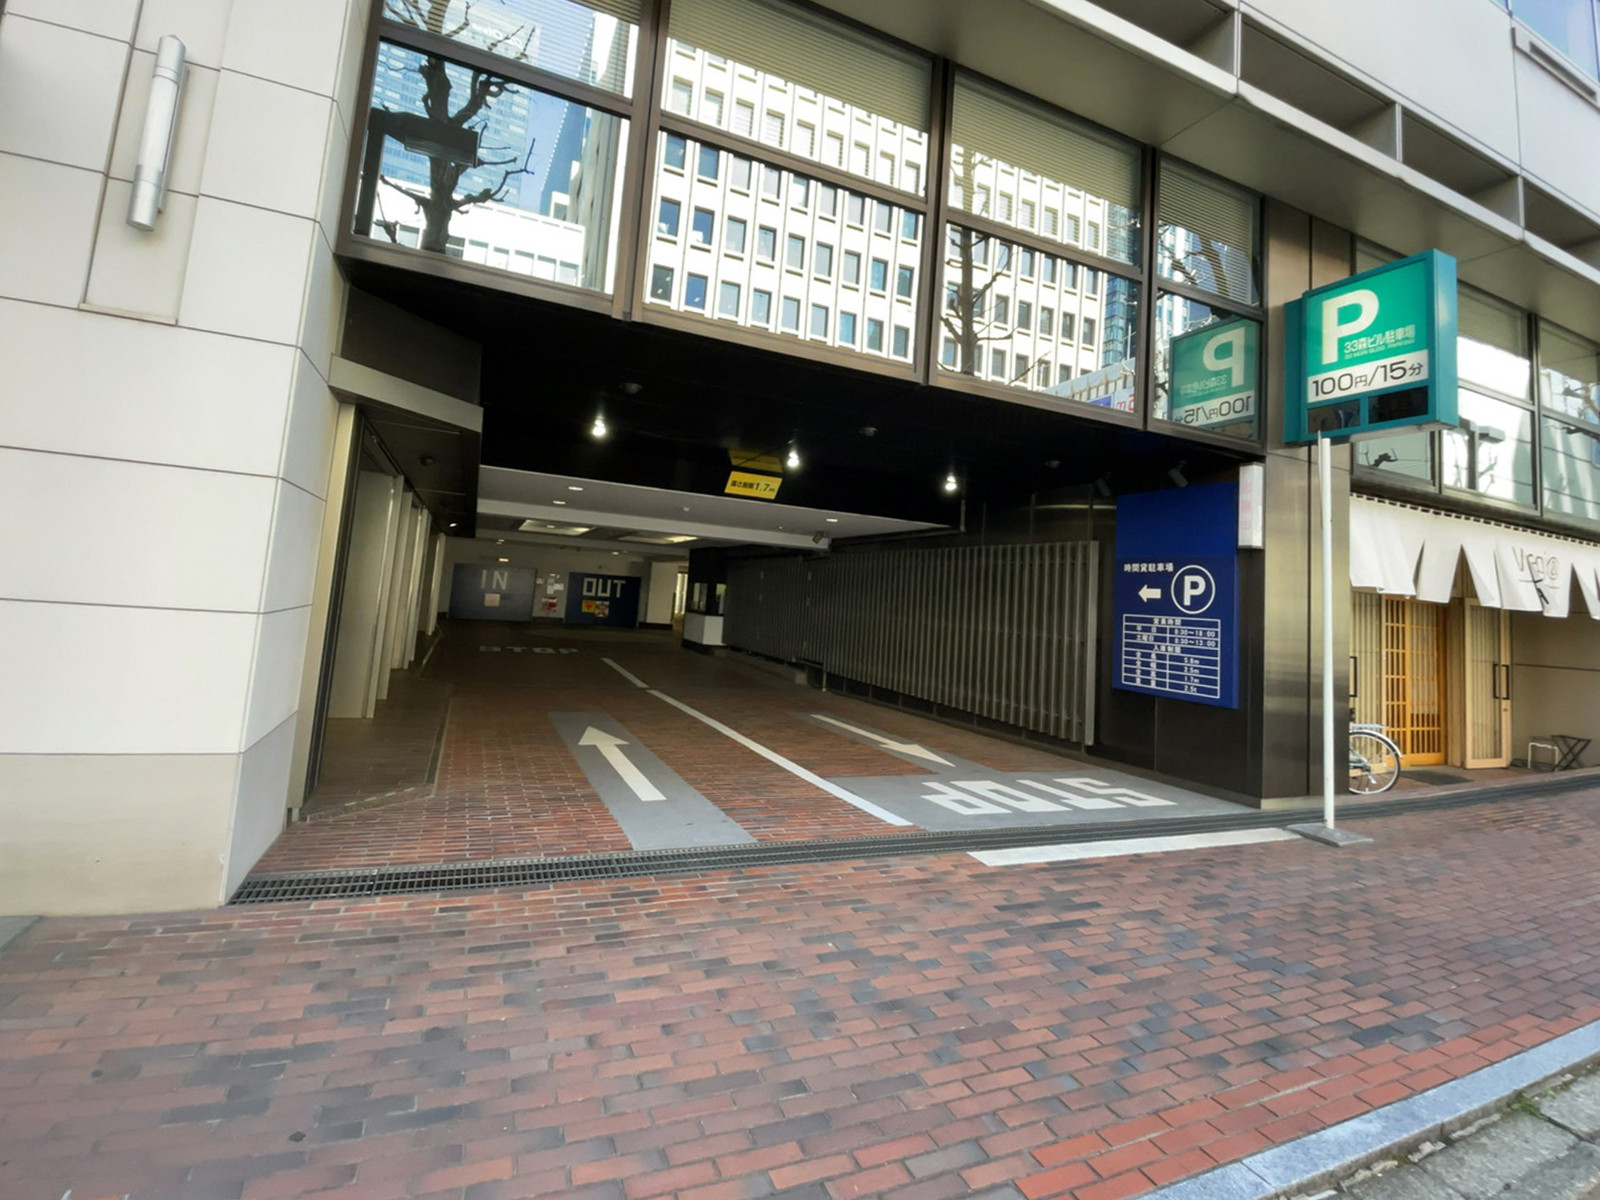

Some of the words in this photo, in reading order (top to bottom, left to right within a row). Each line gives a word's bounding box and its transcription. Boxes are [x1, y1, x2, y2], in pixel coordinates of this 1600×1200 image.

[1322, 289, 1379, 365] P
[480, 569, 508, 590] IN
[582, 577, 626, 598] OUT
[1183, 575, 1206, 606] P
[920, 777, 1178, 815] STOP
